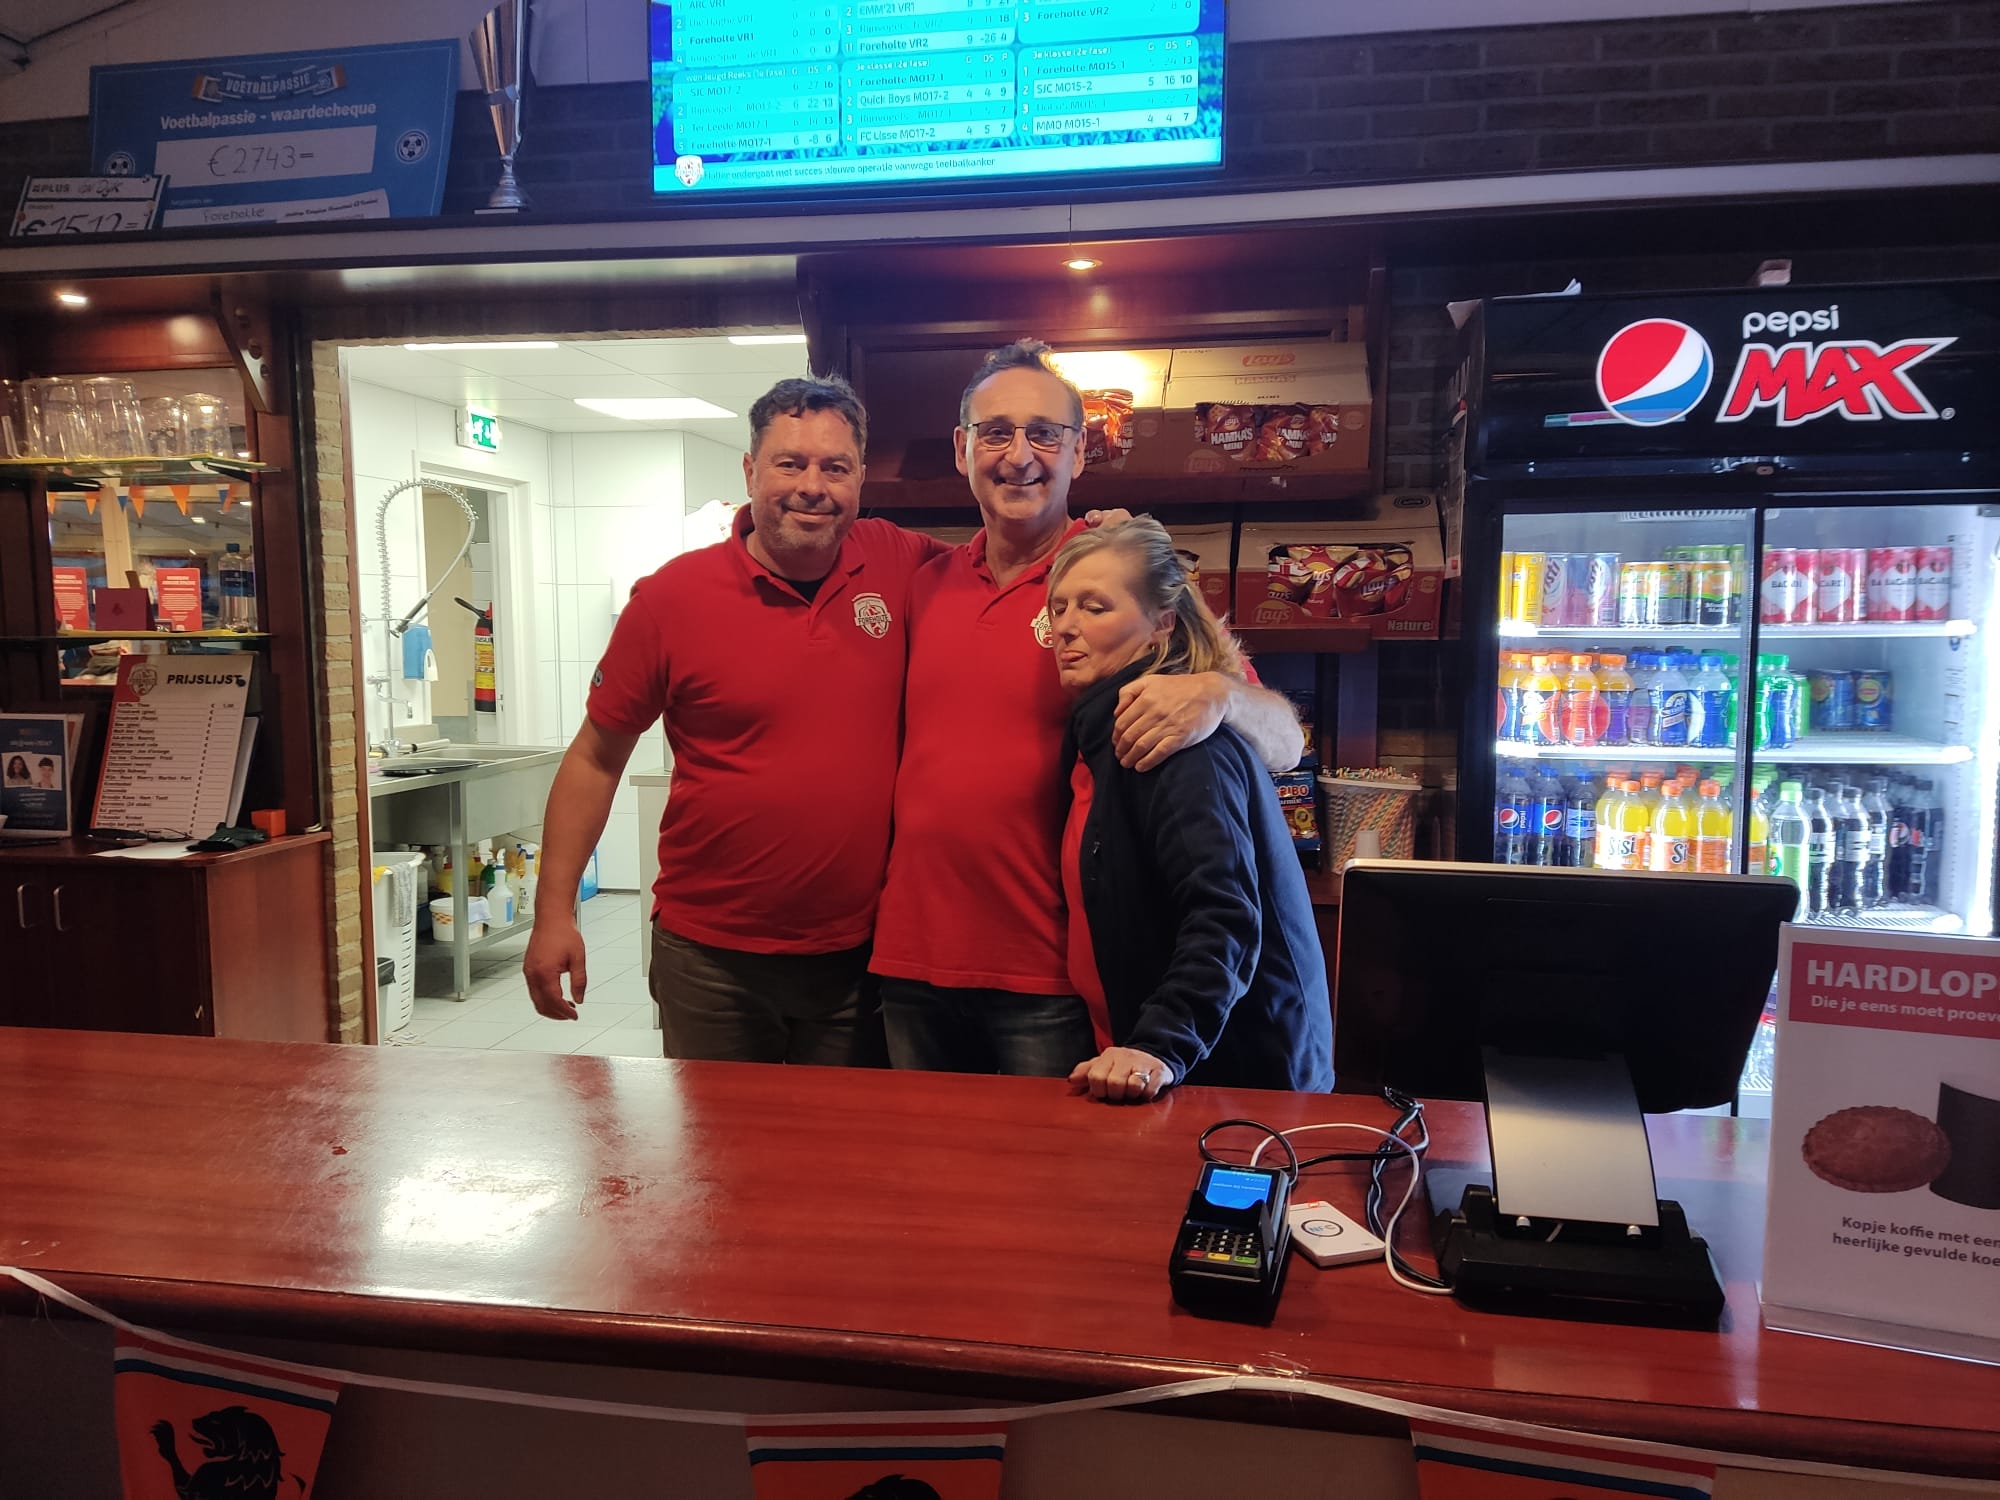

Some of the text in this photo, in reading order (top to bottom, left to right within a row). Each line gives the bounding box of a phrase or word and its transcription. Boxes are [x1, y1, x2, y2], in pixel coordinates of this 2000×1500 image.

[1024, 12, 1030, 22] 3
[1038, 10, 1086, 20] Foreholte
[1090, 7, 1110, 16] VR2
[690, 35, 735, 46] Foreholte
[737, 33, 754, 42] VR1
[860, 40, 906, 51] Foreholte
[910, 38, 928, 48] VR2
[1037, 64, 1085, 75] Foreholte
[1089, 61, 1124, 72] MO151
[226, 72, 311, 93] VOETBALPASSIE
[860, 75, 906, 86] Foreholte
[910, 73, 944, 83] MO171
[1055, 82, 1092, 92] MO15-2
[1148, 77, 1154, 86] 5
[1166, 76, 1175, 85] 16
[1182, 74, 1192, 84] 10
[708, 86, 741, 96] MO172
[860, 95, 886, 106] Quick
[888, 94, 910, 104] Boys
[914, 91, 948, 102] MO17-2
[1001, 87, 1006, 96] 9
[160, 110, 256, 130] Voetbalpassie
[271, 103, 377, 122] waardecheque
[1037, 120, 1062, 131] MMO
[1064, 118, 1100, 128] MO15-1
[860, 132, 872, 141] FC
[874, 130, 898, 140] Lisse
[900, 128, 936, 138] MO17-2
[691, 140, 738, 150] Foreholte
[739, 137, 772, 147] MO17-1
[43, 184, 70, 193] PLUS
[1742, 305, 1840, 338] pepsi
[1715, 337, 1959, 427] MAX
[1211, 427, 1253, 444] HAMKA'S
[1256, 606, 1290, 624] Lay's
[167, 674, 243, 685] PRIJSLIJST
[1278, 784, 1309, 798] RIBO
[1807, 960, 1999, 1000] HARDLOP
[1811, 995, 1838, 1008] Die
[1840, 998, 1856, 1012] je
[1860, 1001, 1897, 1014] eens
[1901, 1005, 1944, 1018] moet
[1308, 1224, 1336, 1234] NFC
[1842, 1216, 1886, 1234] Kopje
[1890, 1222, 1934, 1239] koffie
[1938, 1232, 1970, 1244] met
[1833, 1233, 1900, 1252] heerlijke
[1904, 1246, 1968, 1262] gevulde
